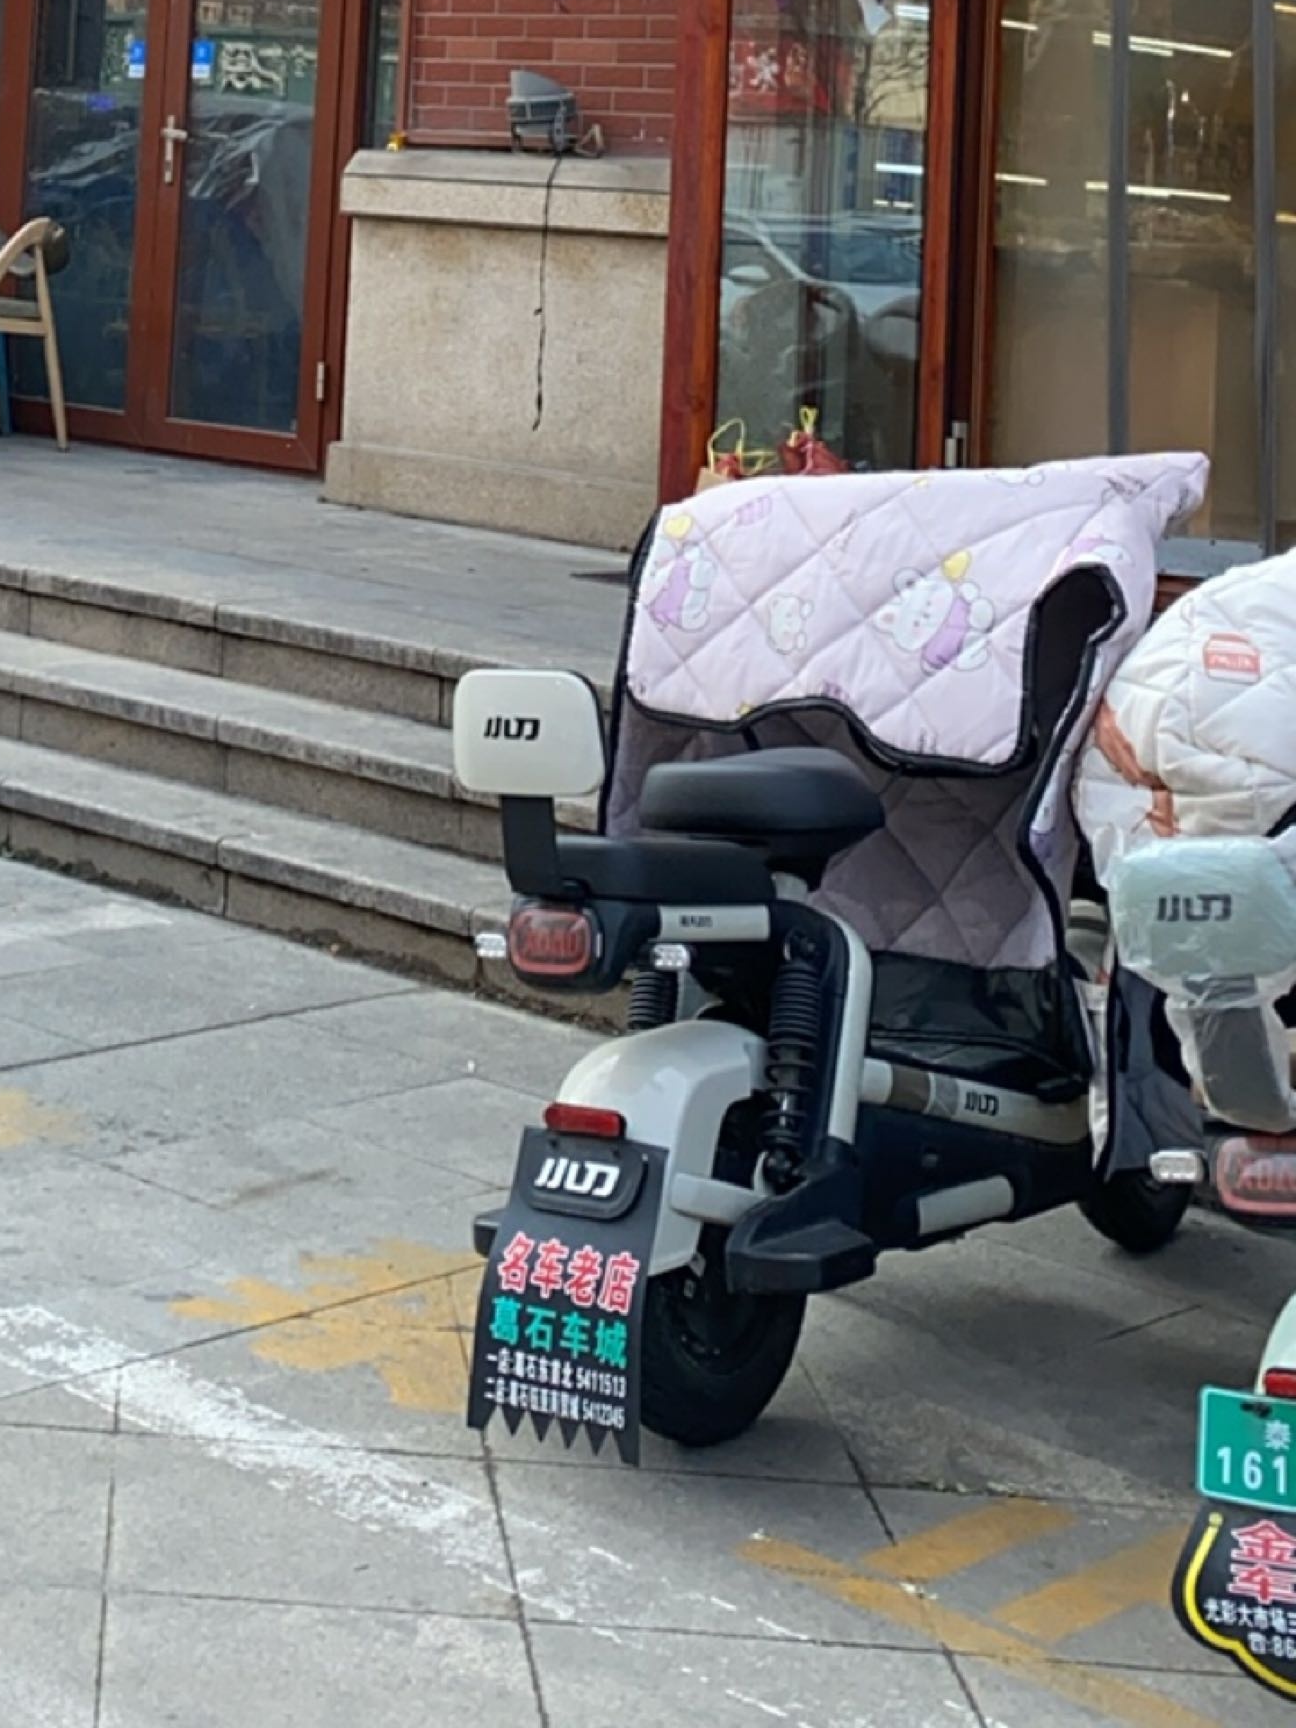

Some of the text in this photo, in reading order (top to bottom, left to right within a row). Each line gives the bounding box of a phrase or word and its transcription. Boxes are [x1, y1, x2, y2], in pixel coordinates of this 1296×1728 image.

[489, 1296, 628, 1369] 葛石车城
[1217, 1446, 1288, 1495] 161
